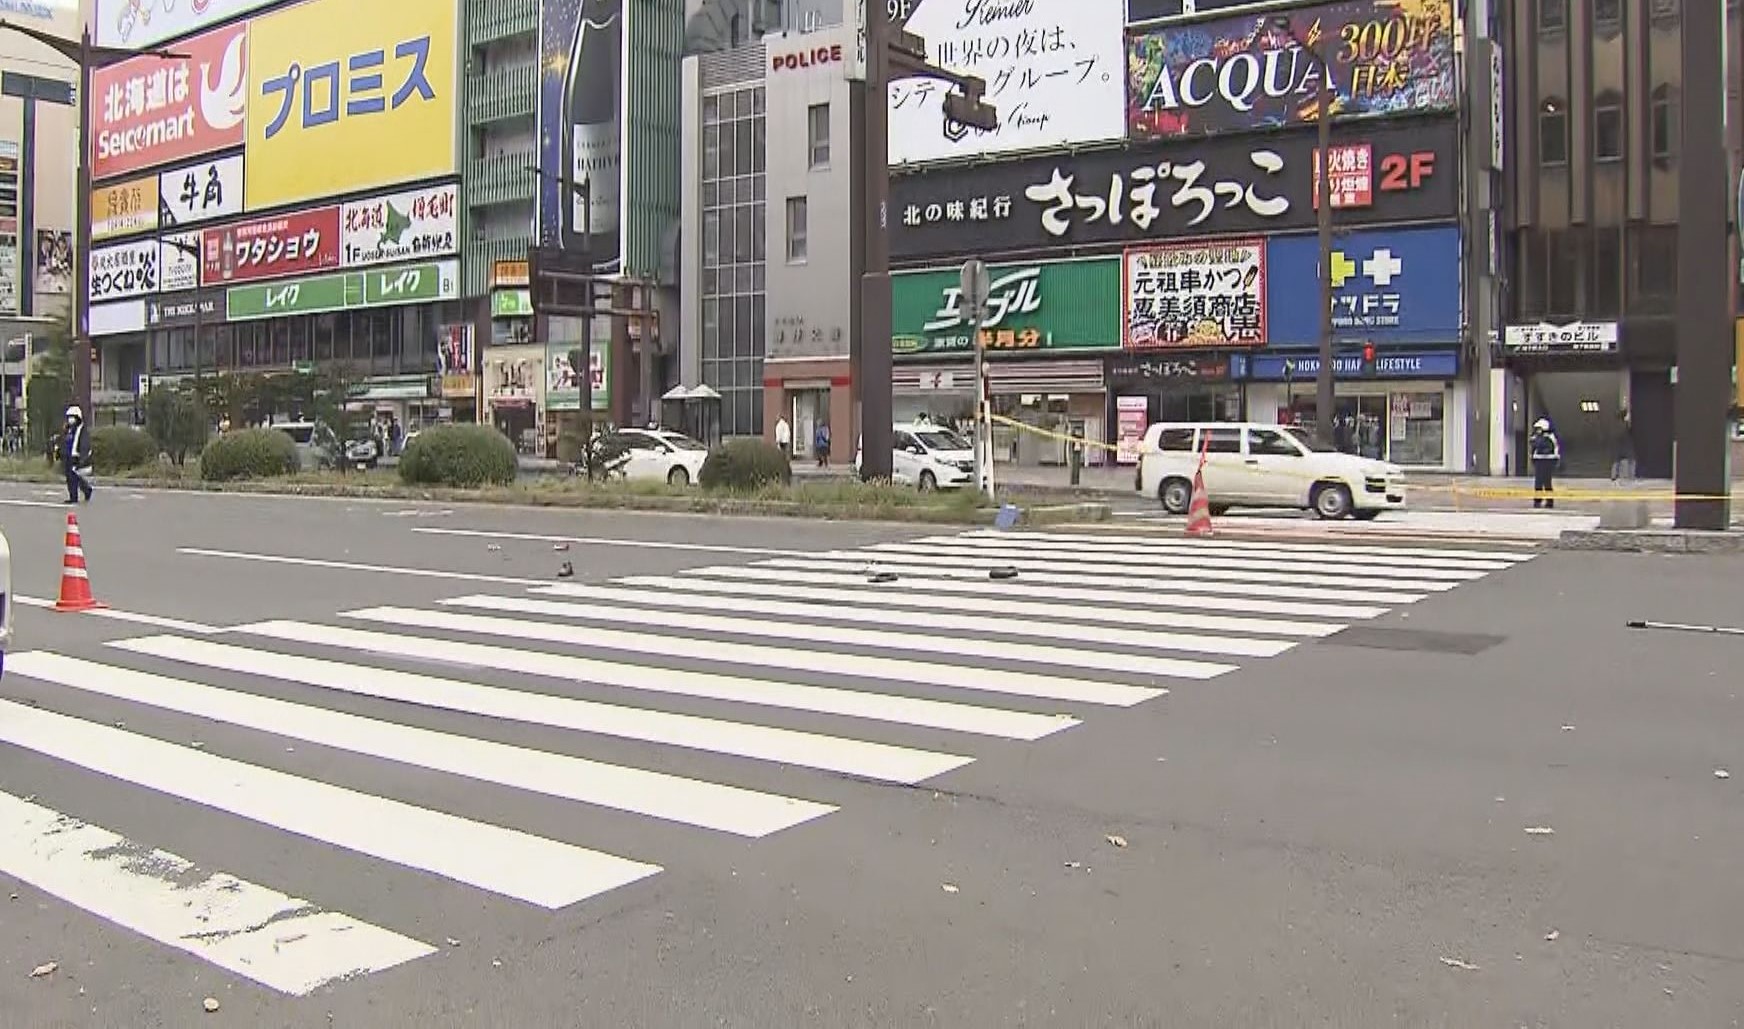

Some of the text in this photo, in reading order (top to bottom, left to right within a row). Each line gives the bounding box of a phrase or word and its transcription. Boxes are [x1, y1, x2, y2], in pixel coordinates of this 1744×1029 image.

[772, 45, 842, 72] POLICE
[939, 26, 1075, 67] 世界の夜は、
[104, 62, 189, 123] 北海道は
[262, 36, 436, 140] プロミス
[1141, 46, 1337, 112] ACQUA
[1314, 146, 1368, 174] 火焼き
[1380, 152, 1435, 191] 2F
[180, 163, 223, 212] 牛角
[1024, 149, 1290, 235] さっぽろっこ
[903, 194, 1013, 227] 北の味紀行
[345, 241, 361, 263] 1F
[266, 284, 300, 308] レイク
[382, 270, 422, 297] レイク
[924, 267, 1042, 331] エブル
[1134, 269, 1243, 294] 元祖串かつ
